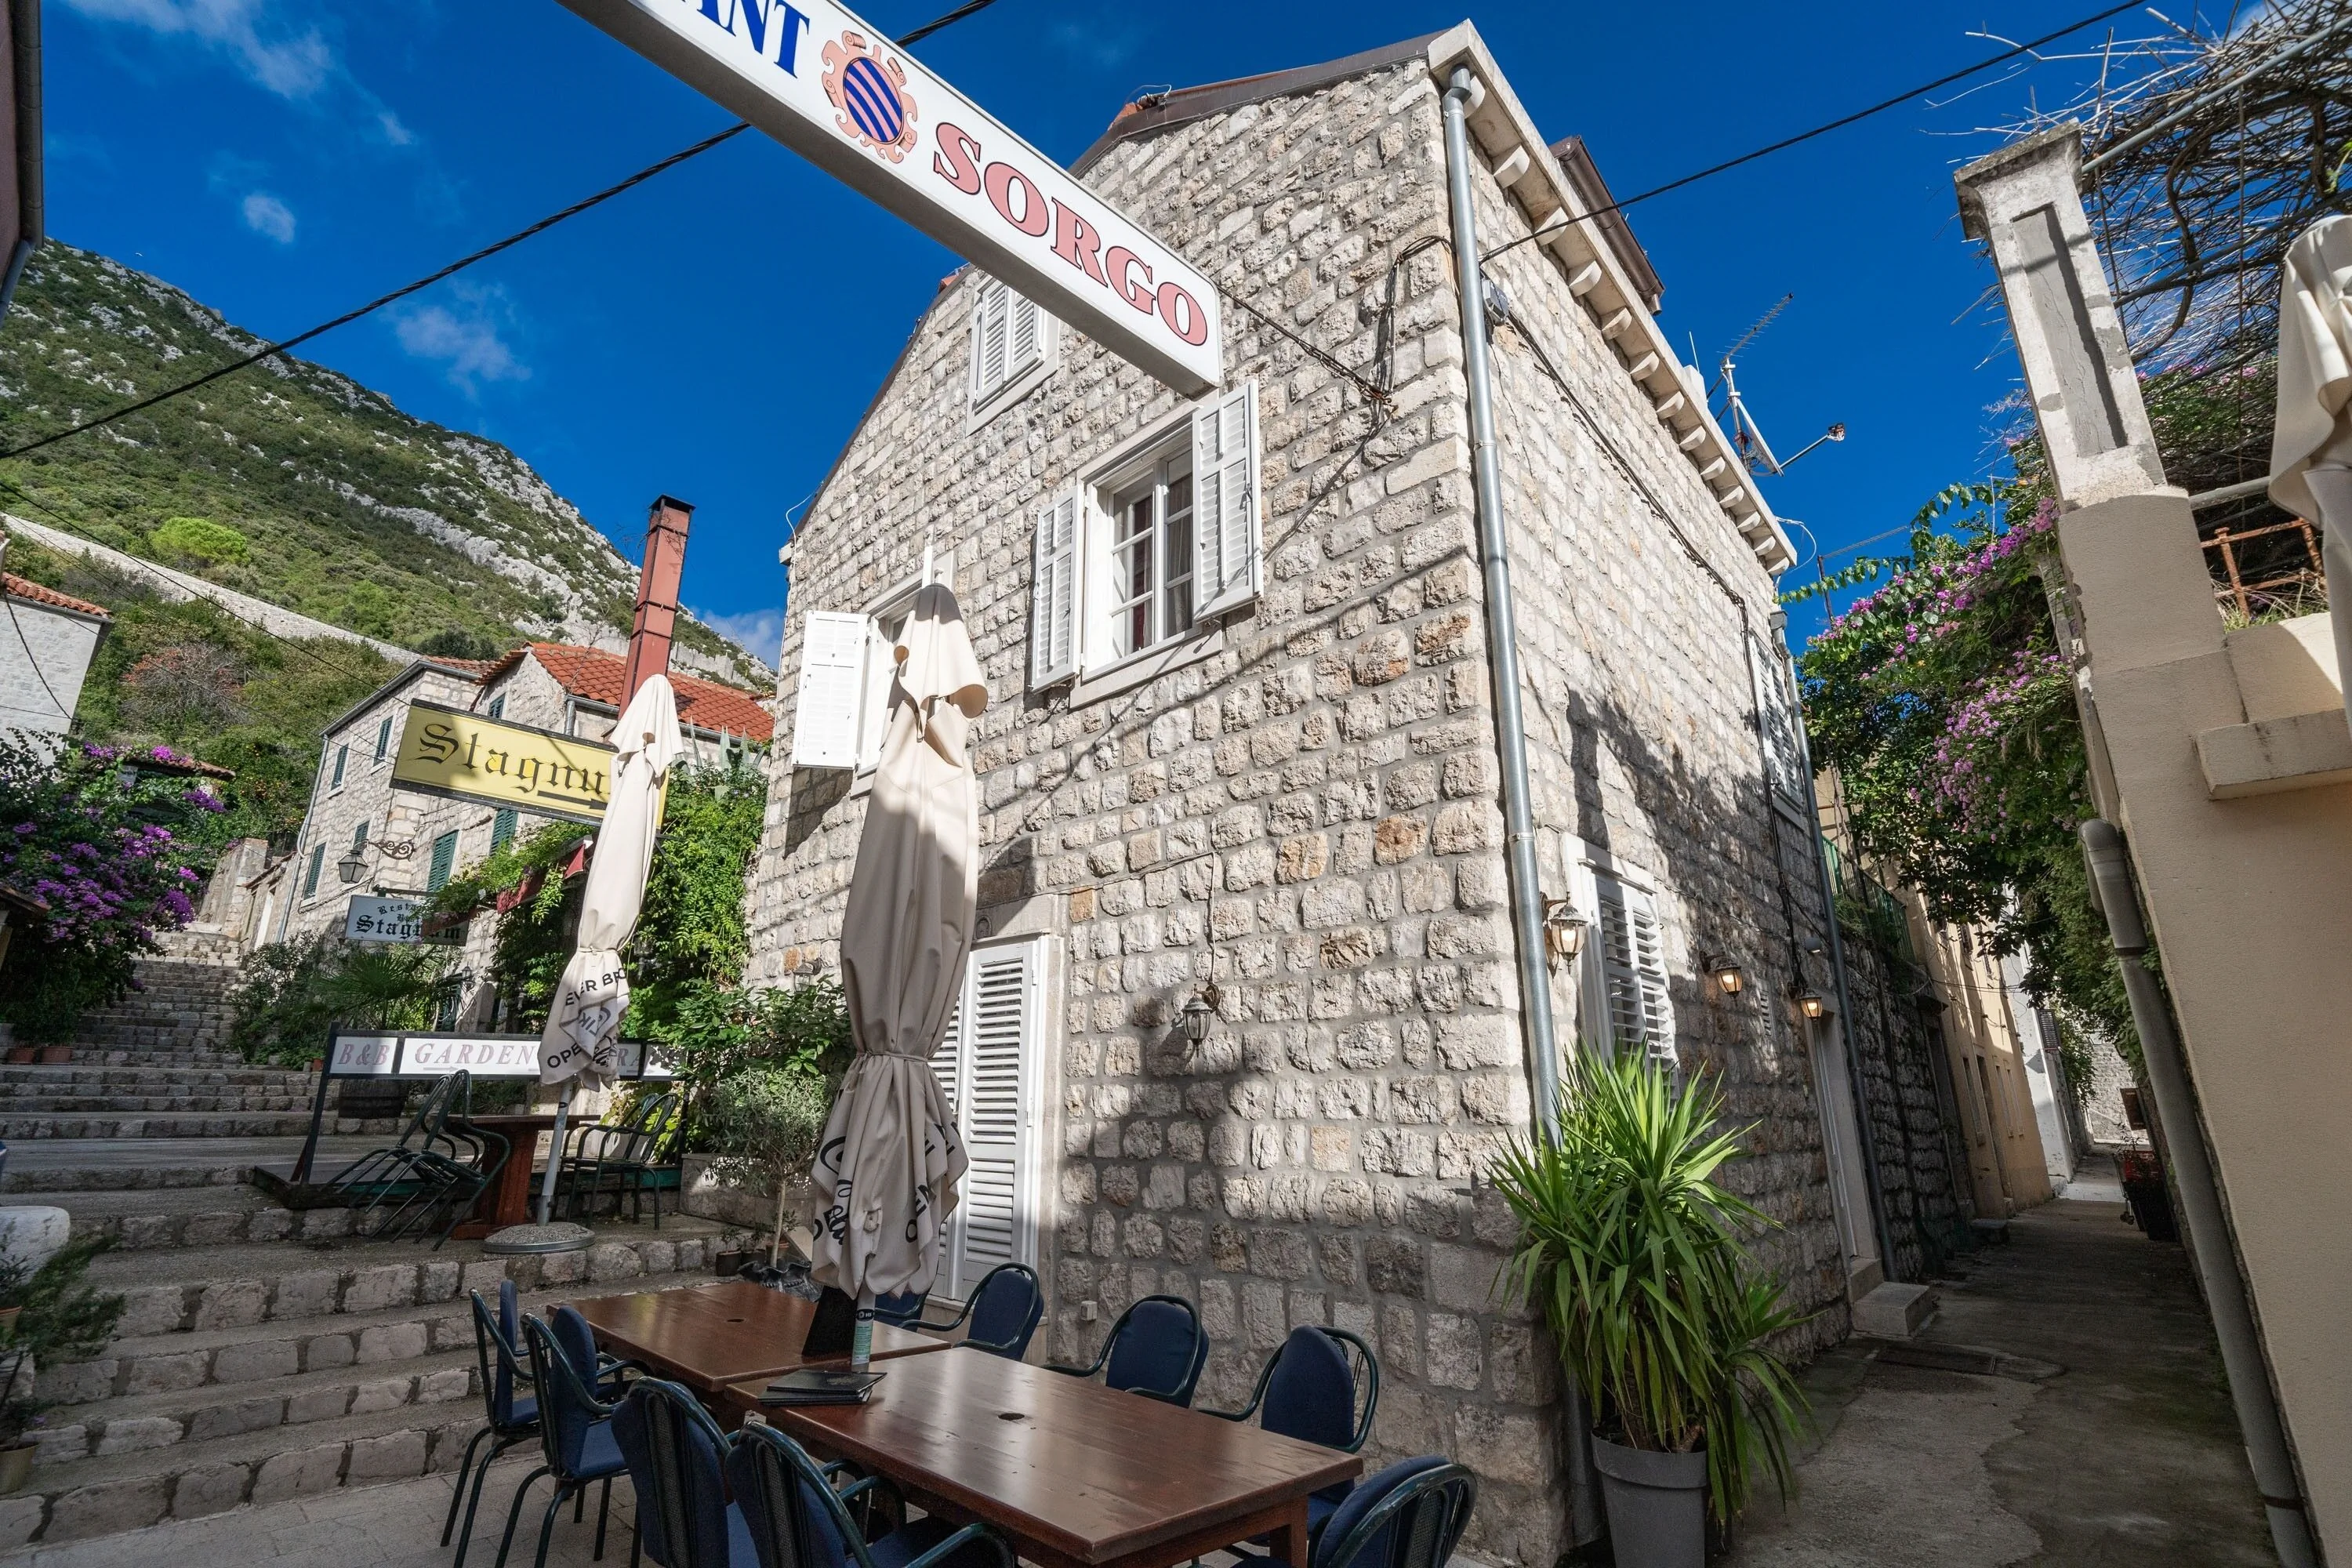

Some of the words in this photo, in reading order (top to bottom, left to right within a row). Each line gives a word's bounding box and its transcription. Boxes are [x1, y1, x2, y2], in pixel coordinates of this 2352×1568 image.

[682, 0, 810, 78] NT
[934, 122, 1207, 346] SORGO
[409, 723, 611, 794] Stagnu
[354, 914, 460, 939] Stagnm
[415, 1043, 536, 1065] GARDEN
